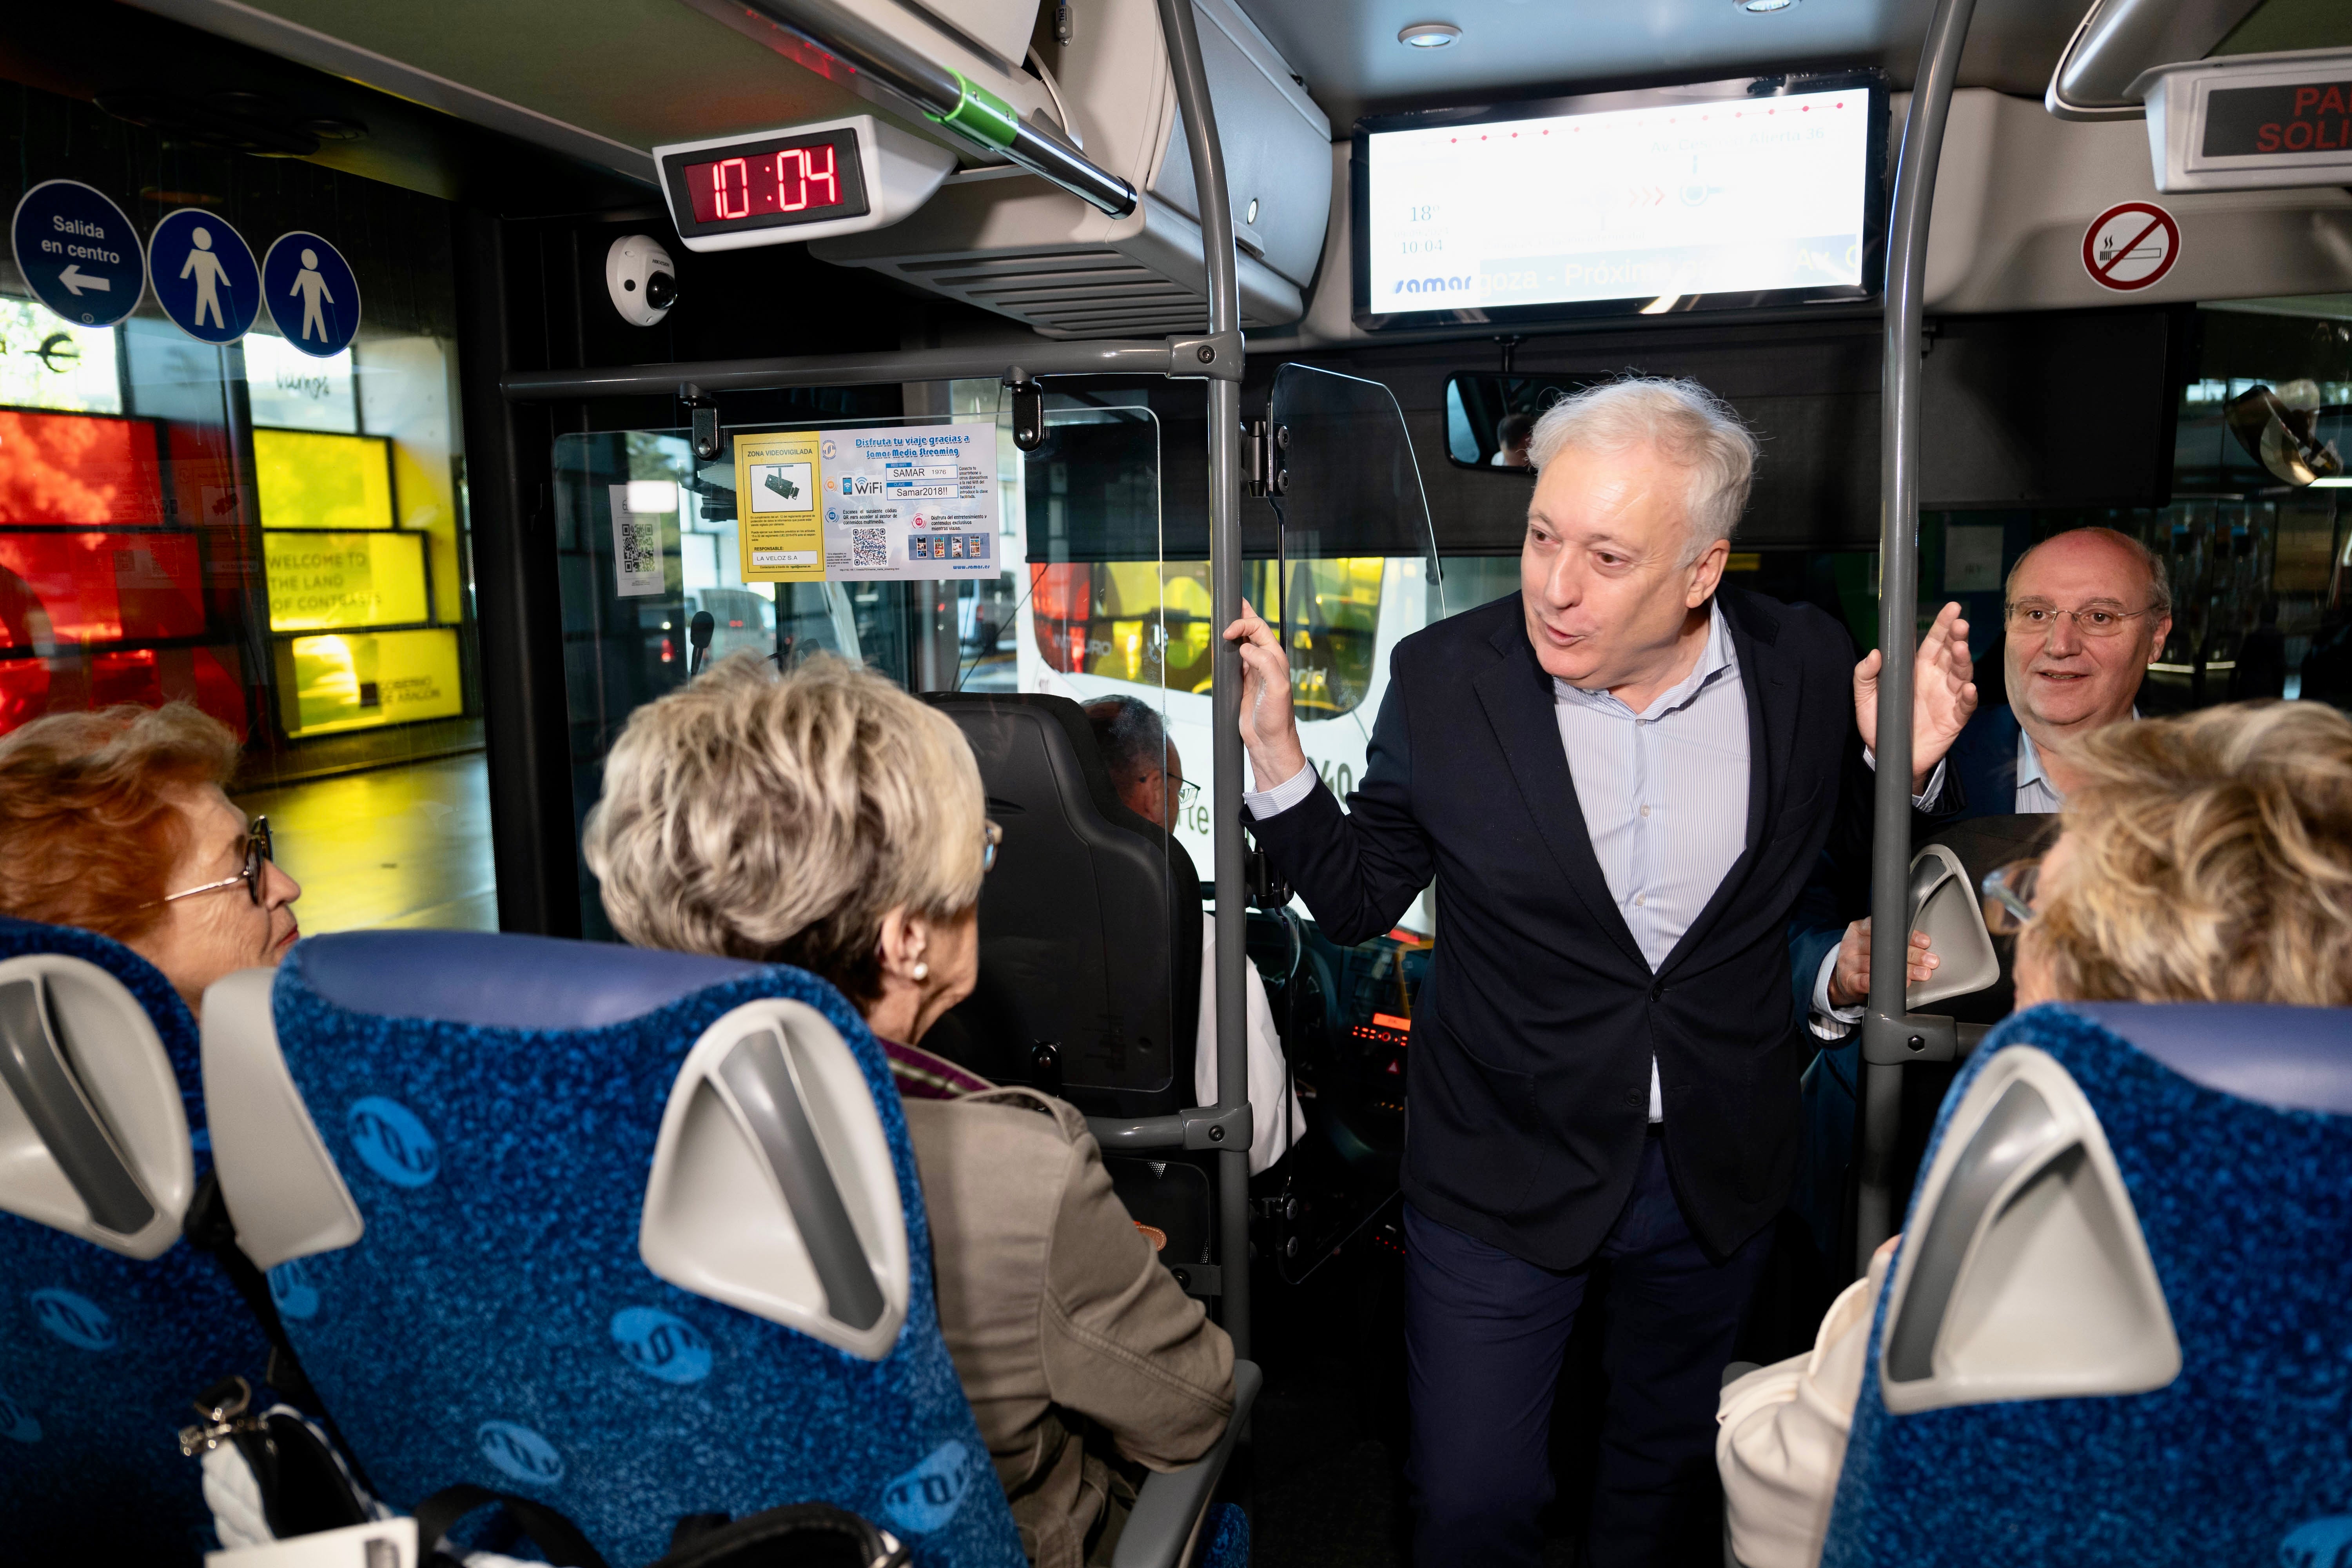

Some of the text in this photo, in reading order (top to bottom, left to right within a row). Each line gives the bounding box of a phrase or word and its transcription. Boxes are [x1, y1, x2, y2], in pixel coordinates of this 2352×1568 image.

[2294, 86, 2352, 116] PA
[1805, 126, 1825, 140] 36
[713, 146, 835, 219] 10:04
[53, 215, 105, 239] Salida
[41, 239, 120, 264] en centro
[1400, 239, 1443, 255] 10:04
[652, 258, 670, 267] HIKVISION
[1391, 275, 1473, 295] samar
[856, 438, 892, 447] Disfruta
[894, 437, 903, 446] tu
[905, 436, 927, 447] viaje
[929, 435, 962, 446] gracias
[866, 447, 960, 459] Samar Media Streaming
[893, 468, 925, 477] SAMAR
[855, 482, 882, 494] WiFi
[897, 487, 948, 496] Samar2018!!
[267, 553, 343, 568] WELCOME
[348, 552, 366, 567] TO
[269, 573, 343, 590] THE LAND
[272, 597, 293, 612] OF
